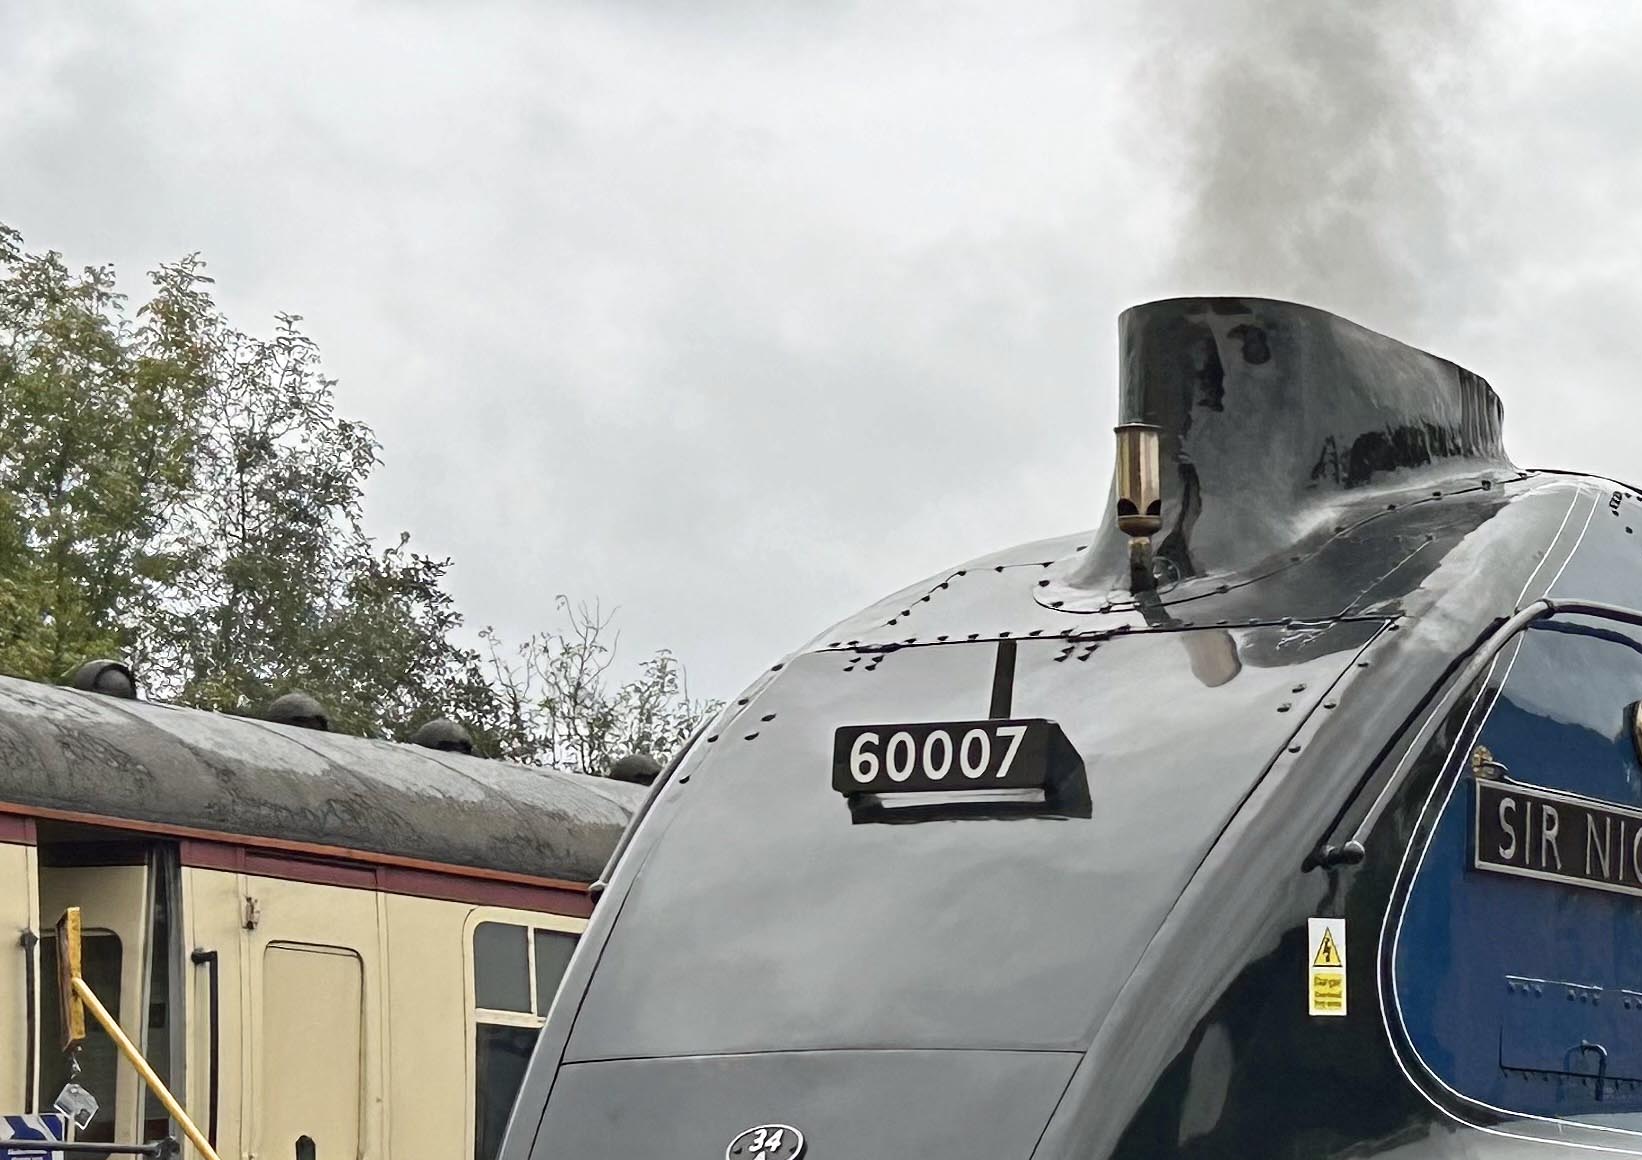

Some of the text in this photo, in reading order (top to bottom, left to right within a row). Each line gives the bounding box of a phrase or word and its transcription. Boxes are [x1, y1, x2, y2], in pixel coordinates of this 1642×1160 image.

[850, 725, 1028, 784] 60007
[1499, 797, 1562, 871] SIR
[748, 1128, 784, 1152] 34
